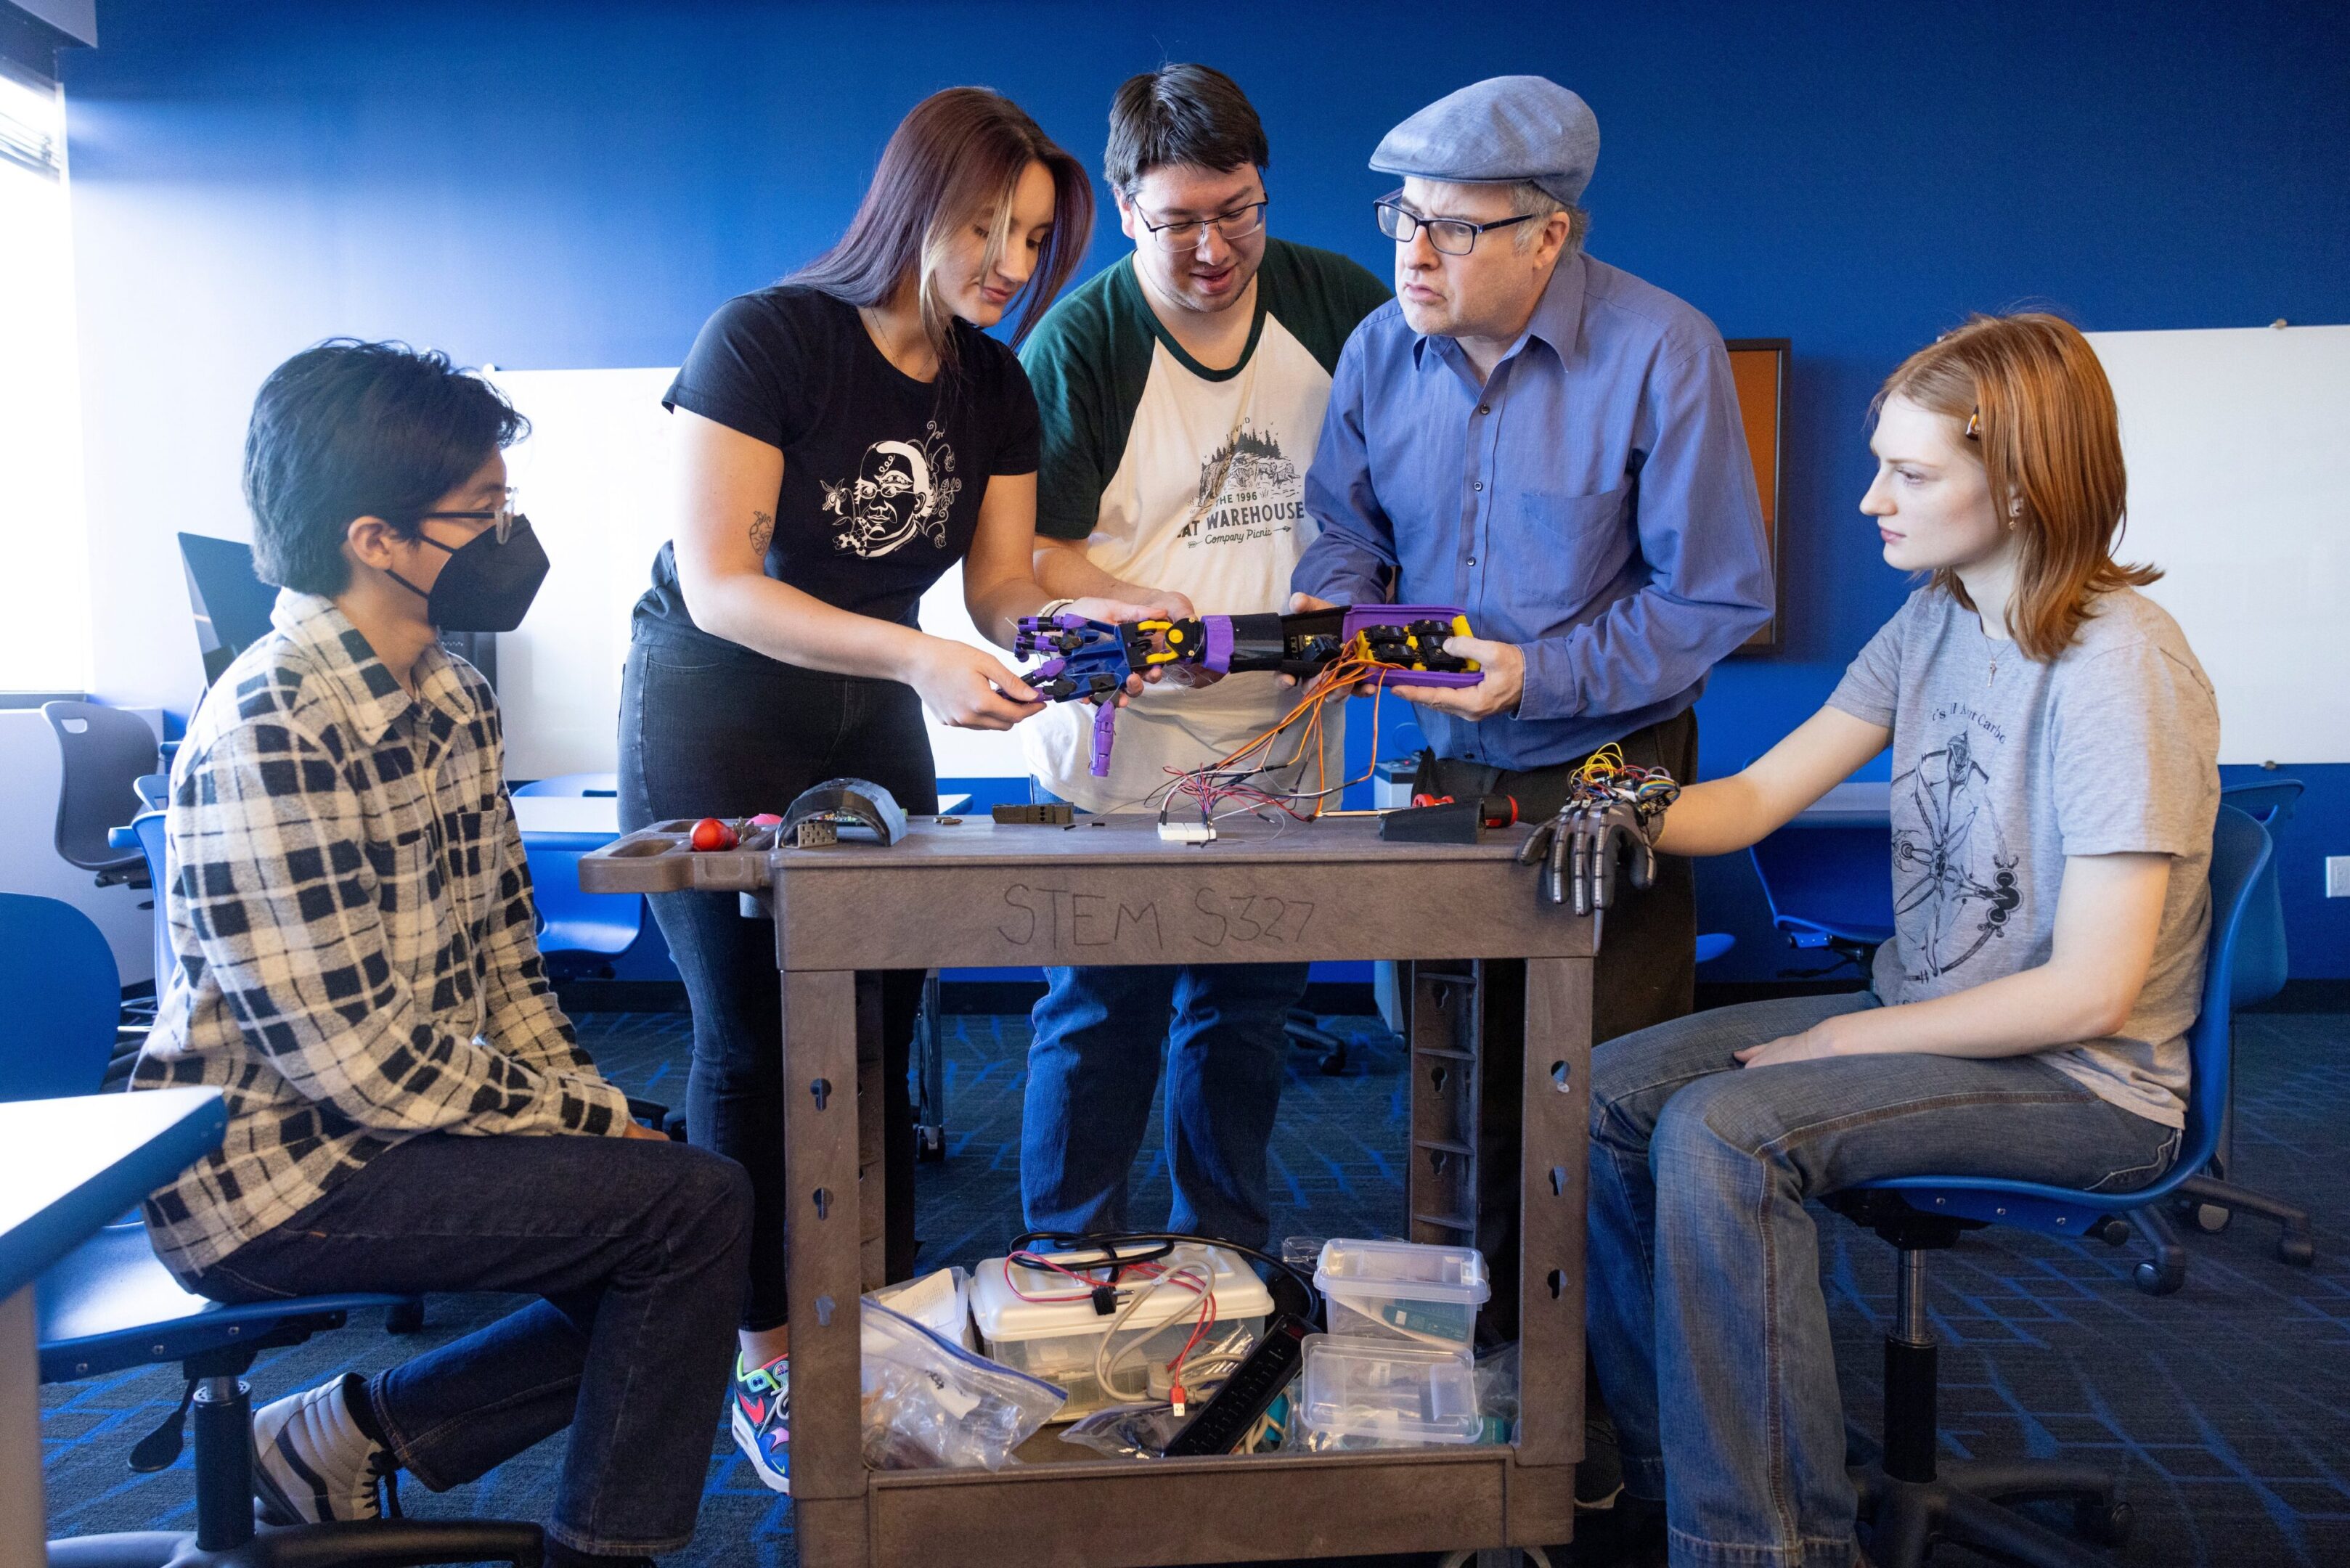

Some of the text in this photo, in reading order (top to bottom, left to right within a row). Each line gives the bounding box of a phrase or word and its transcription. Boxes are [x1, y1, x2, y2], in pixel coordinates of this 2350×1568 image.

[1236, 491, 1257, 502] 1996
[1177, 502, 1305, 538] AT WAREHOUSE
[1205, 528, 1272, 545] Company Picnic
[997, 883, 1315, 950] STEM S327
